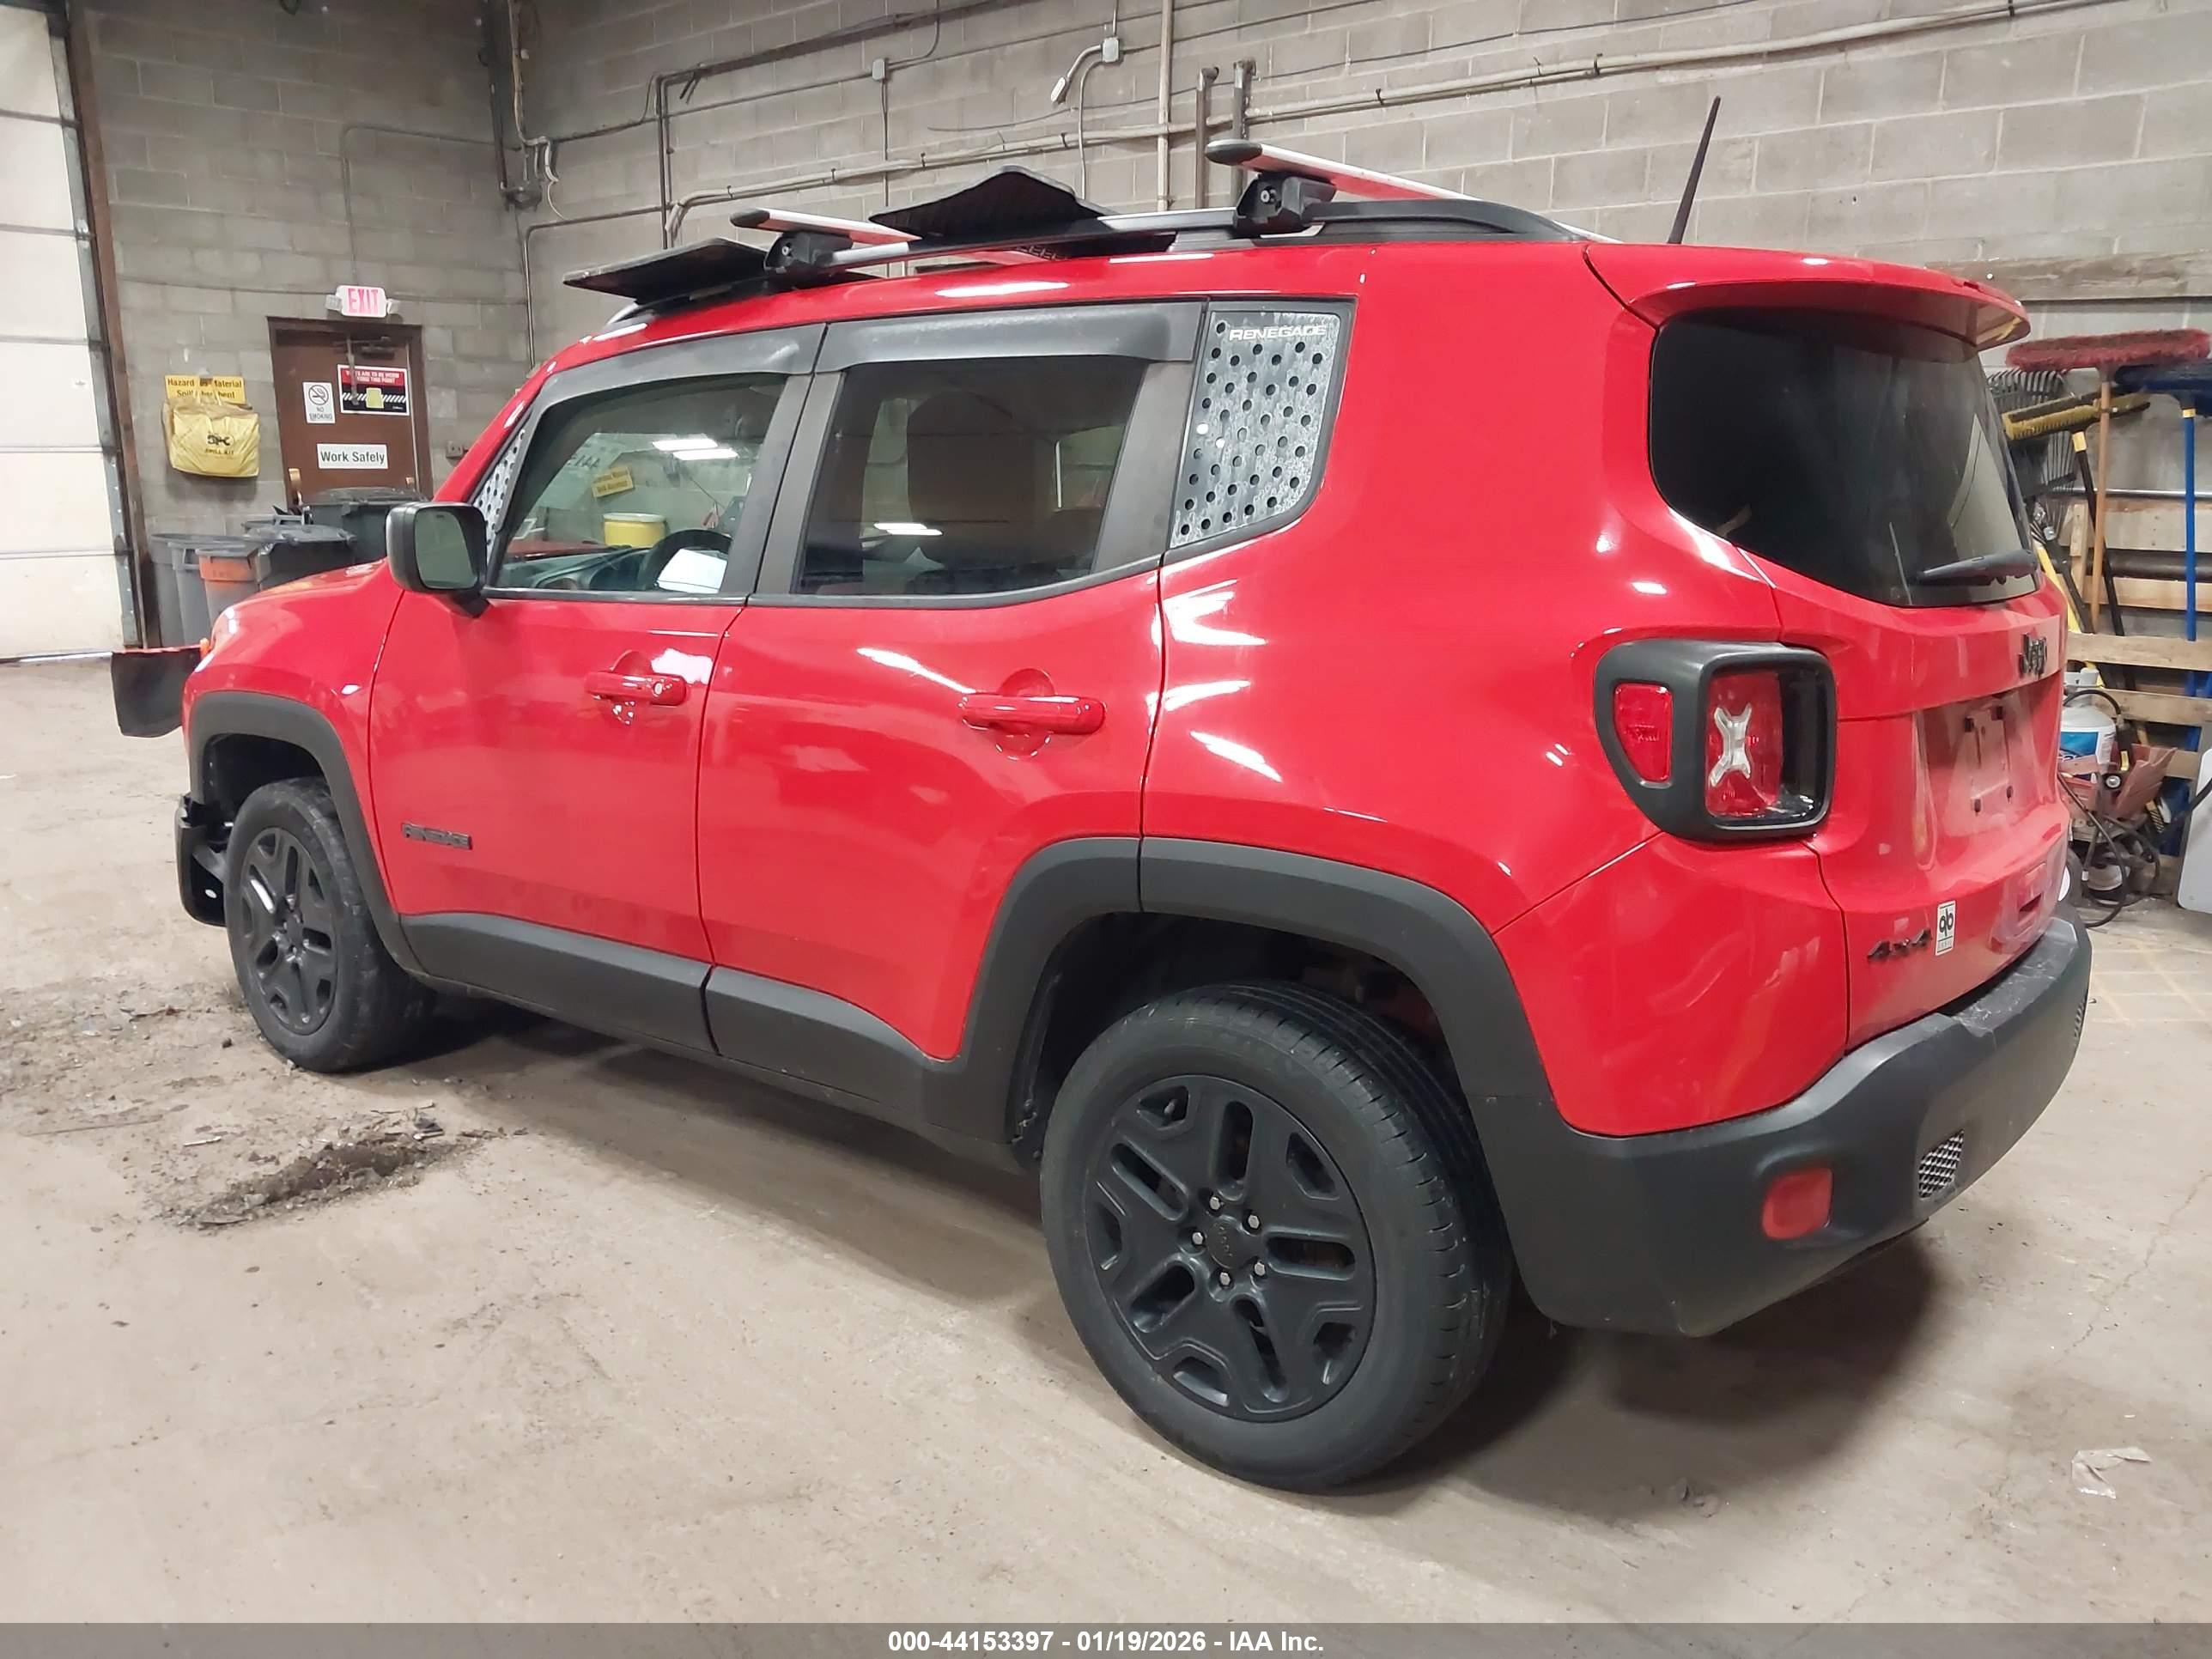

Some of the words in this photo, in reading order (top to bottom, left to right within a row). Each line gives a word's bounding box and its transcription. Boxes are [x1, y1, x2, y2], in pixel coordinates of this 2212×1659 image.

[348, 288, 379, 314] EXIT
[1229, 325, 1327, 341] RENEGADE
[320, 451, 349, 462] Work
[352, 451, 385, 465] Safely
